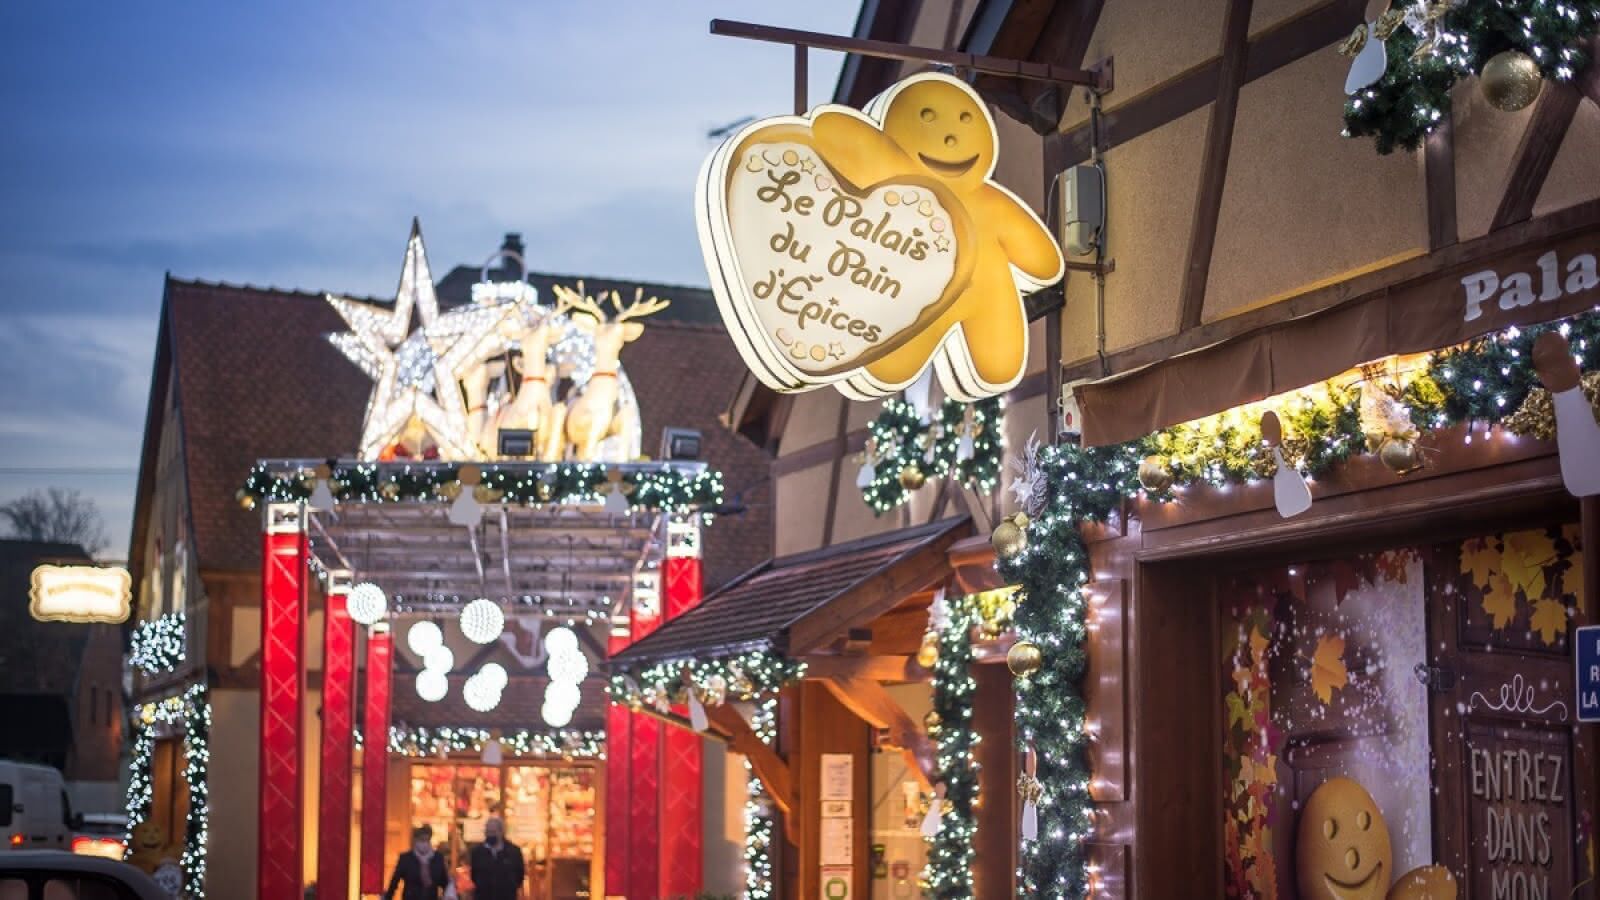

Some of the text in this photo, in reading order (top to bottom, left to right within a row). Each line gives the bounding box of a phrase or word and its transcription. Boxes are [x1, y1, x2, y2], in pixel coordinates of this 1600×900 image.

[757, 169, 930, 261] Le Palais
[770, 221, 901, 299] du Pain
[1460, 250, 1600, 322] Pala
[753, 269, 882, 343] d'Épices
[1471, 748, 1563, 802] ENTREZ
[1487, 806, 1550, 865] DANS
[1491, 868, 1548, 900] MON
